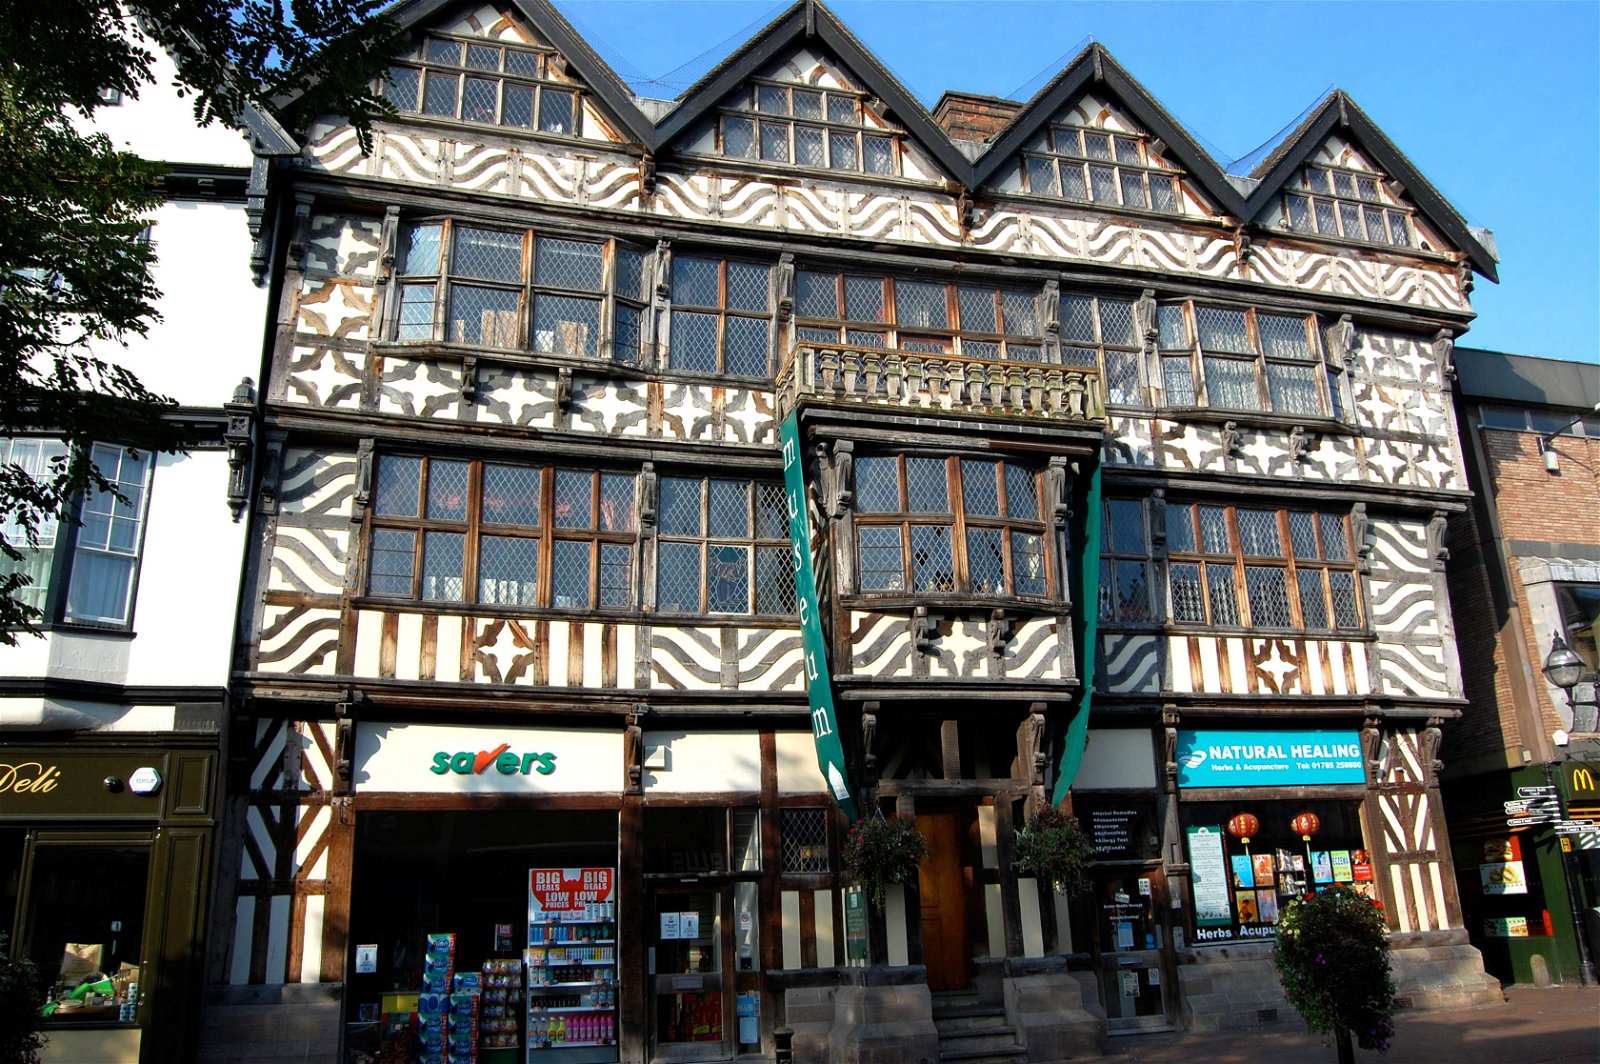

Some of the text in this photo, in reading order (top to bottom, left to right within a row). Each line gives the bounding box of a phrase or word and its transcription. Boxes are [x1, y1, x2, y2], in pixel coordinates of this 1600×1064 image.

[1208, 744, 1361, 760] NATURAL HEALING
[430, 743, 557, 775] savers
[1211, 763, 1234, 771] Herbs
[1235, 763, 1242, 771] &
[1243, 763, 1290, 772] Acupuncture
[536, 871, 560, 884] BIG
[583, 871, 608, 883] BIG
[536, 884, 560, 892] DEALS
[545, 892, 570, 902] LOW
[574, 891, 598, 901] LOW
[1196, 925, 1276, 940] Herbs Acupu
